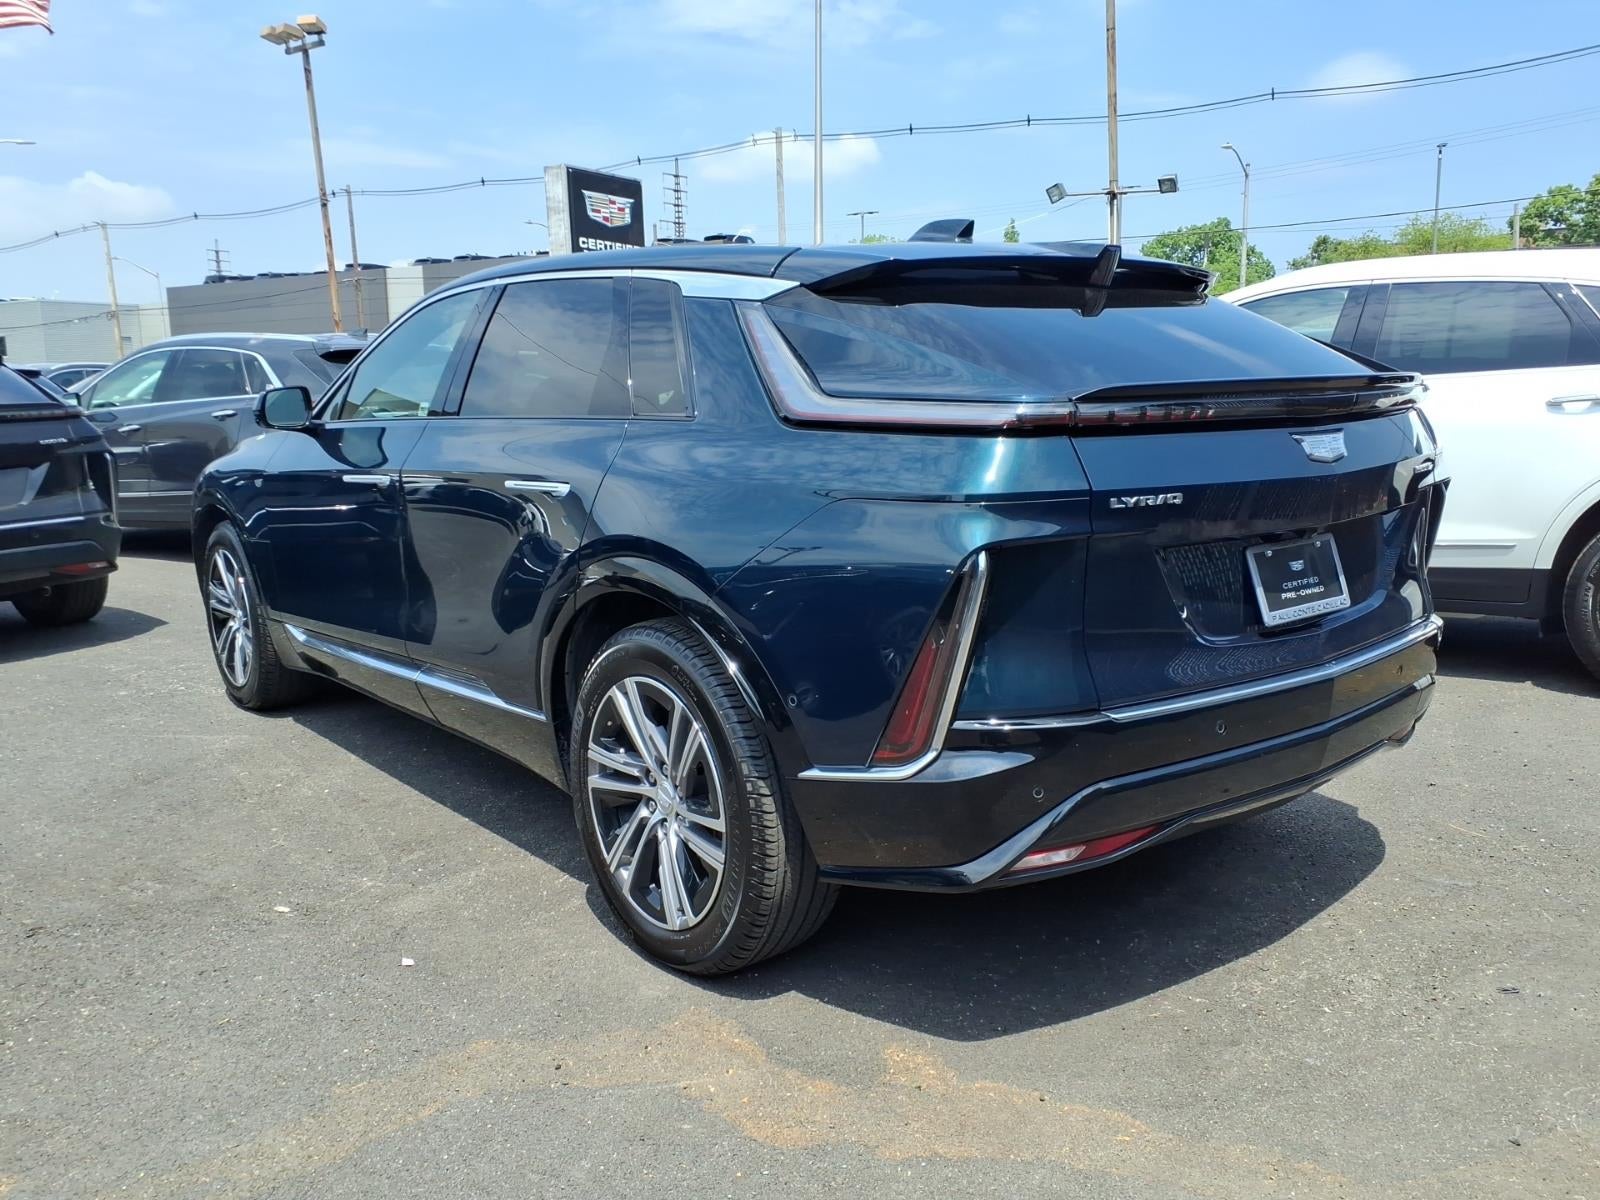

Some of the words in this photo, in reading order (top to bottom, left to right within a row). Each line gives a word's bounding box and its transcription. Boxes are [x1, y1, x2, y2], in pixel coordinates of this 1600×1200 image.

[579, 236, 640, 250] CERTIFI
[1110, 492, 1183, 509] LYRIQ
[1282, 576, 1319, 589] CERTIFIED
[1281, 585, 1325, 600] PRE-OWNED
